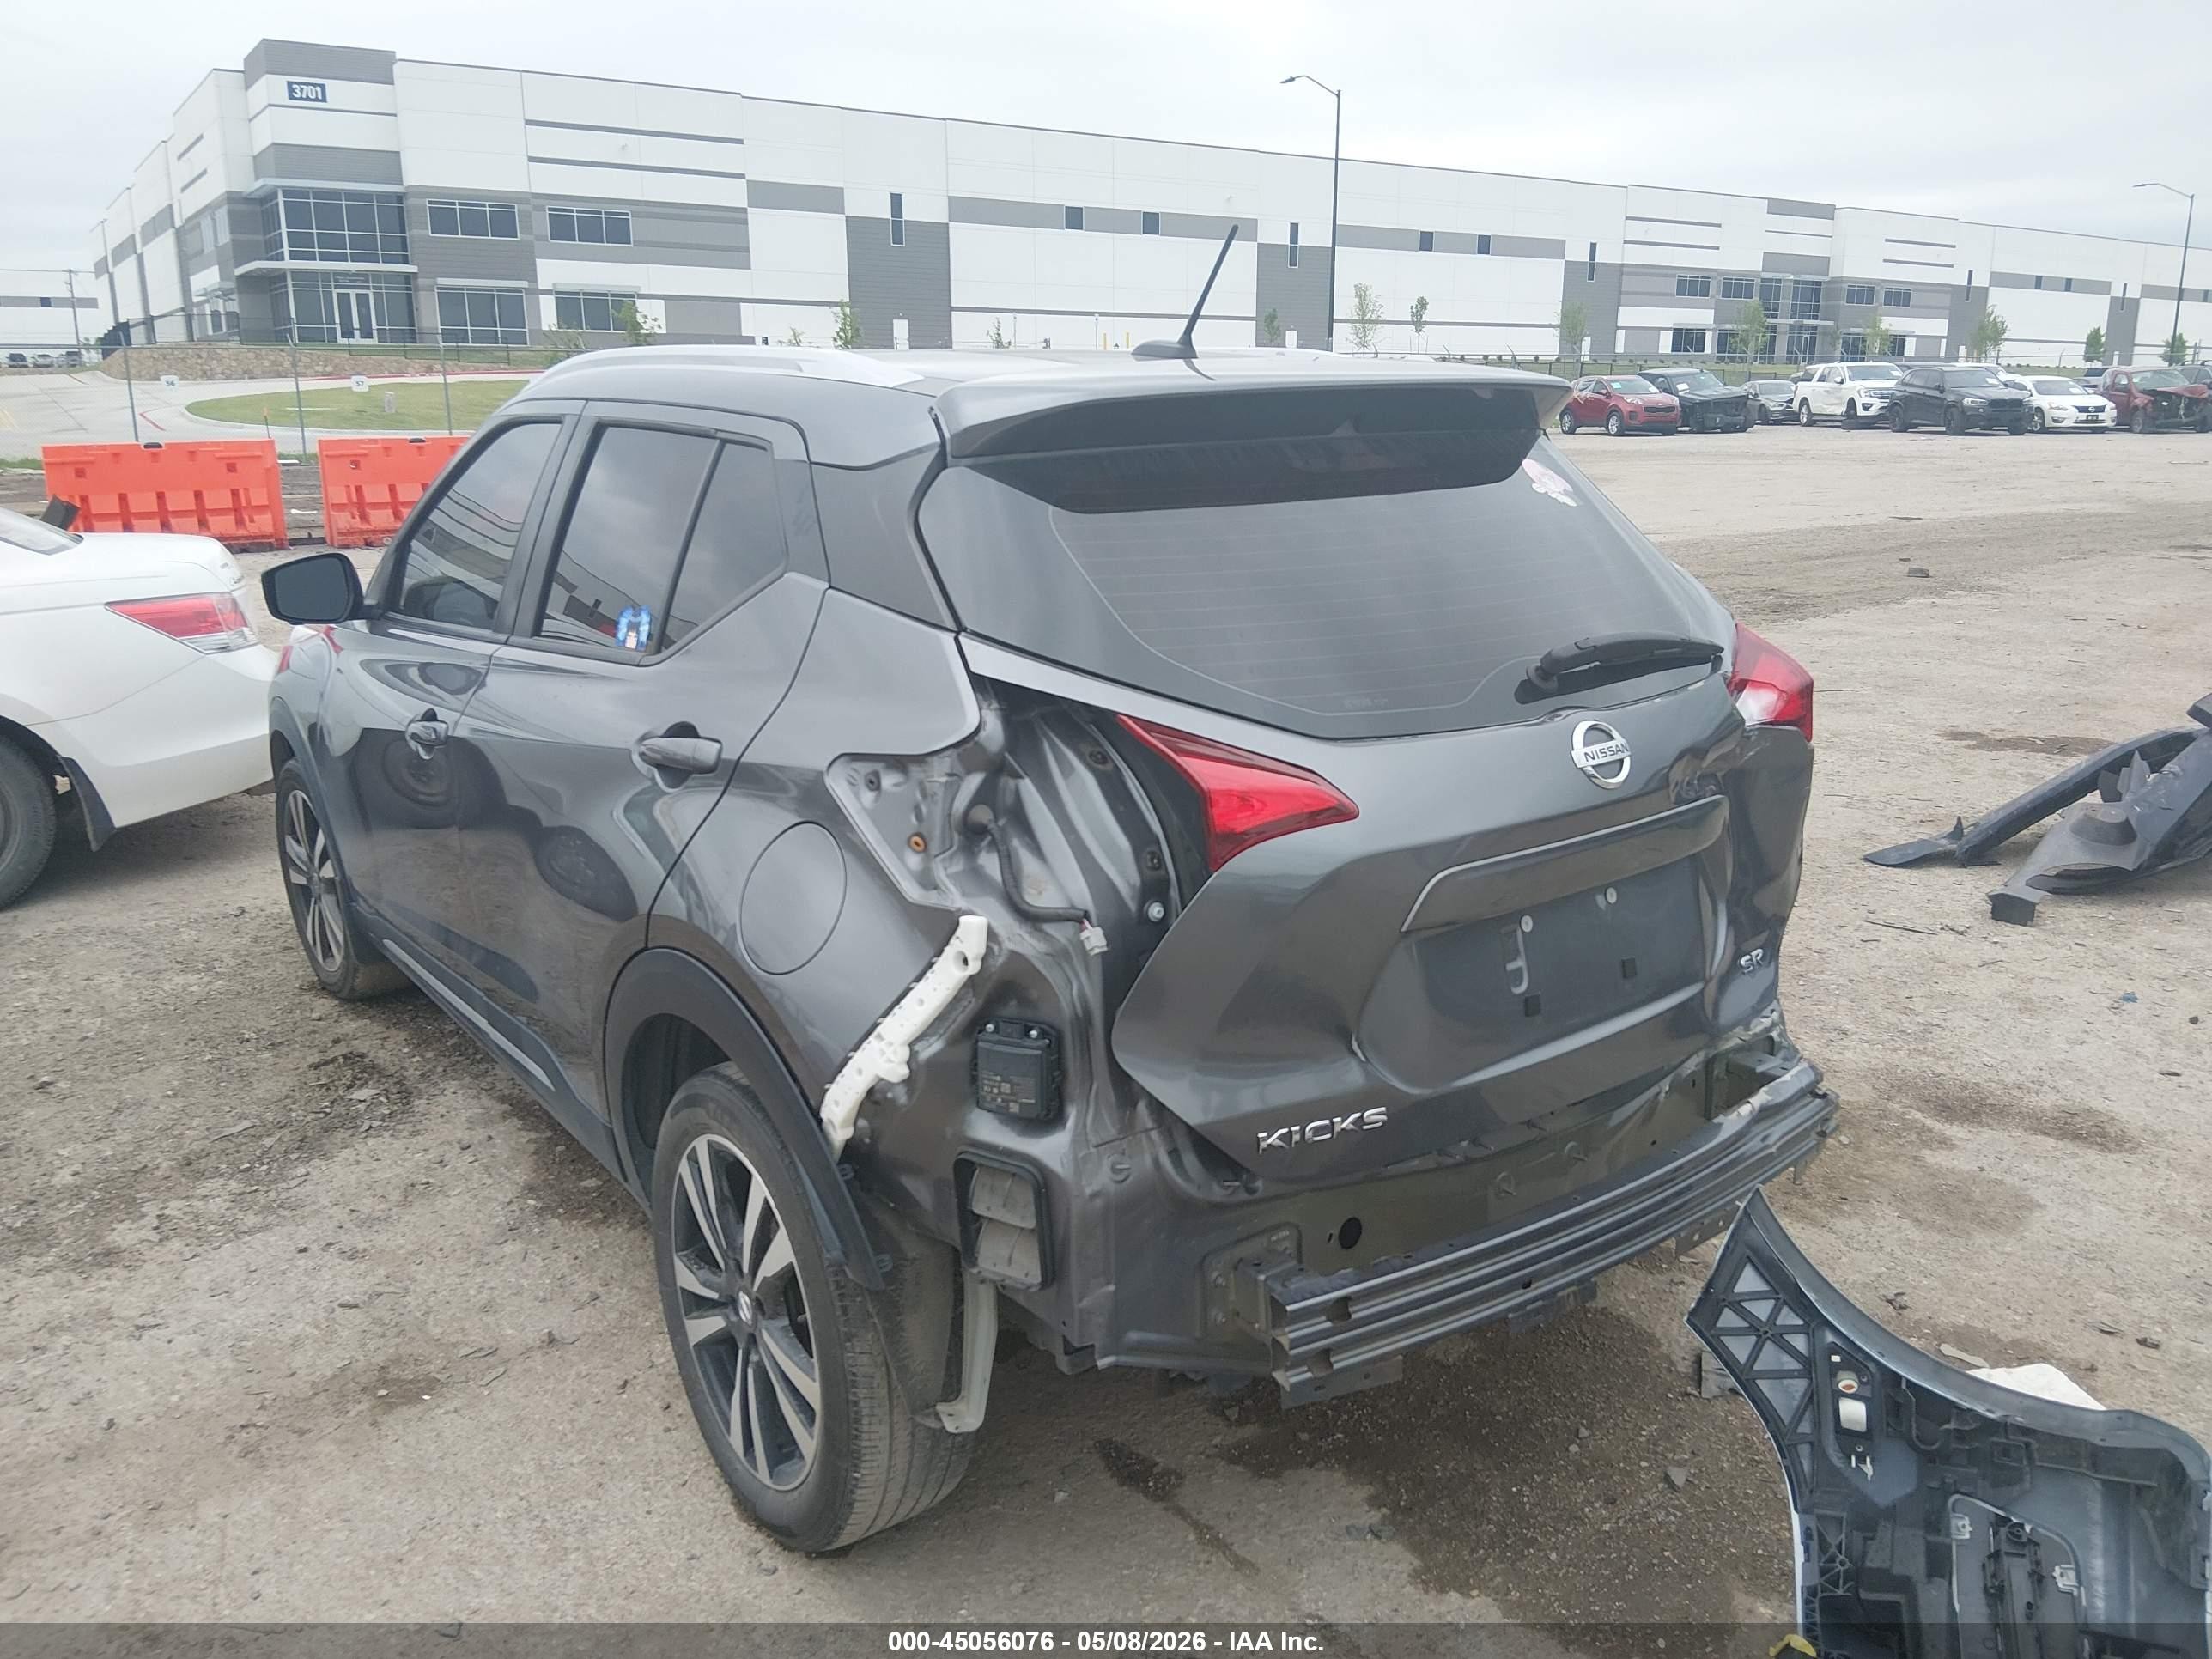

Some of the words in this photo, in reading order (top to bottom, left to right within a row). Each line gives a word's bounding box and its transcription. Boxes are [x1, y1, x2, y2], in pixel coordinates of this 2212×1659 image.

[292, 84, 323, 100] 3701
[1583, 742, 1629, 763] NISSAN
[1740, 948, 1764, 973] SR
[1257, 1106, 1389, 1155] KICKS
